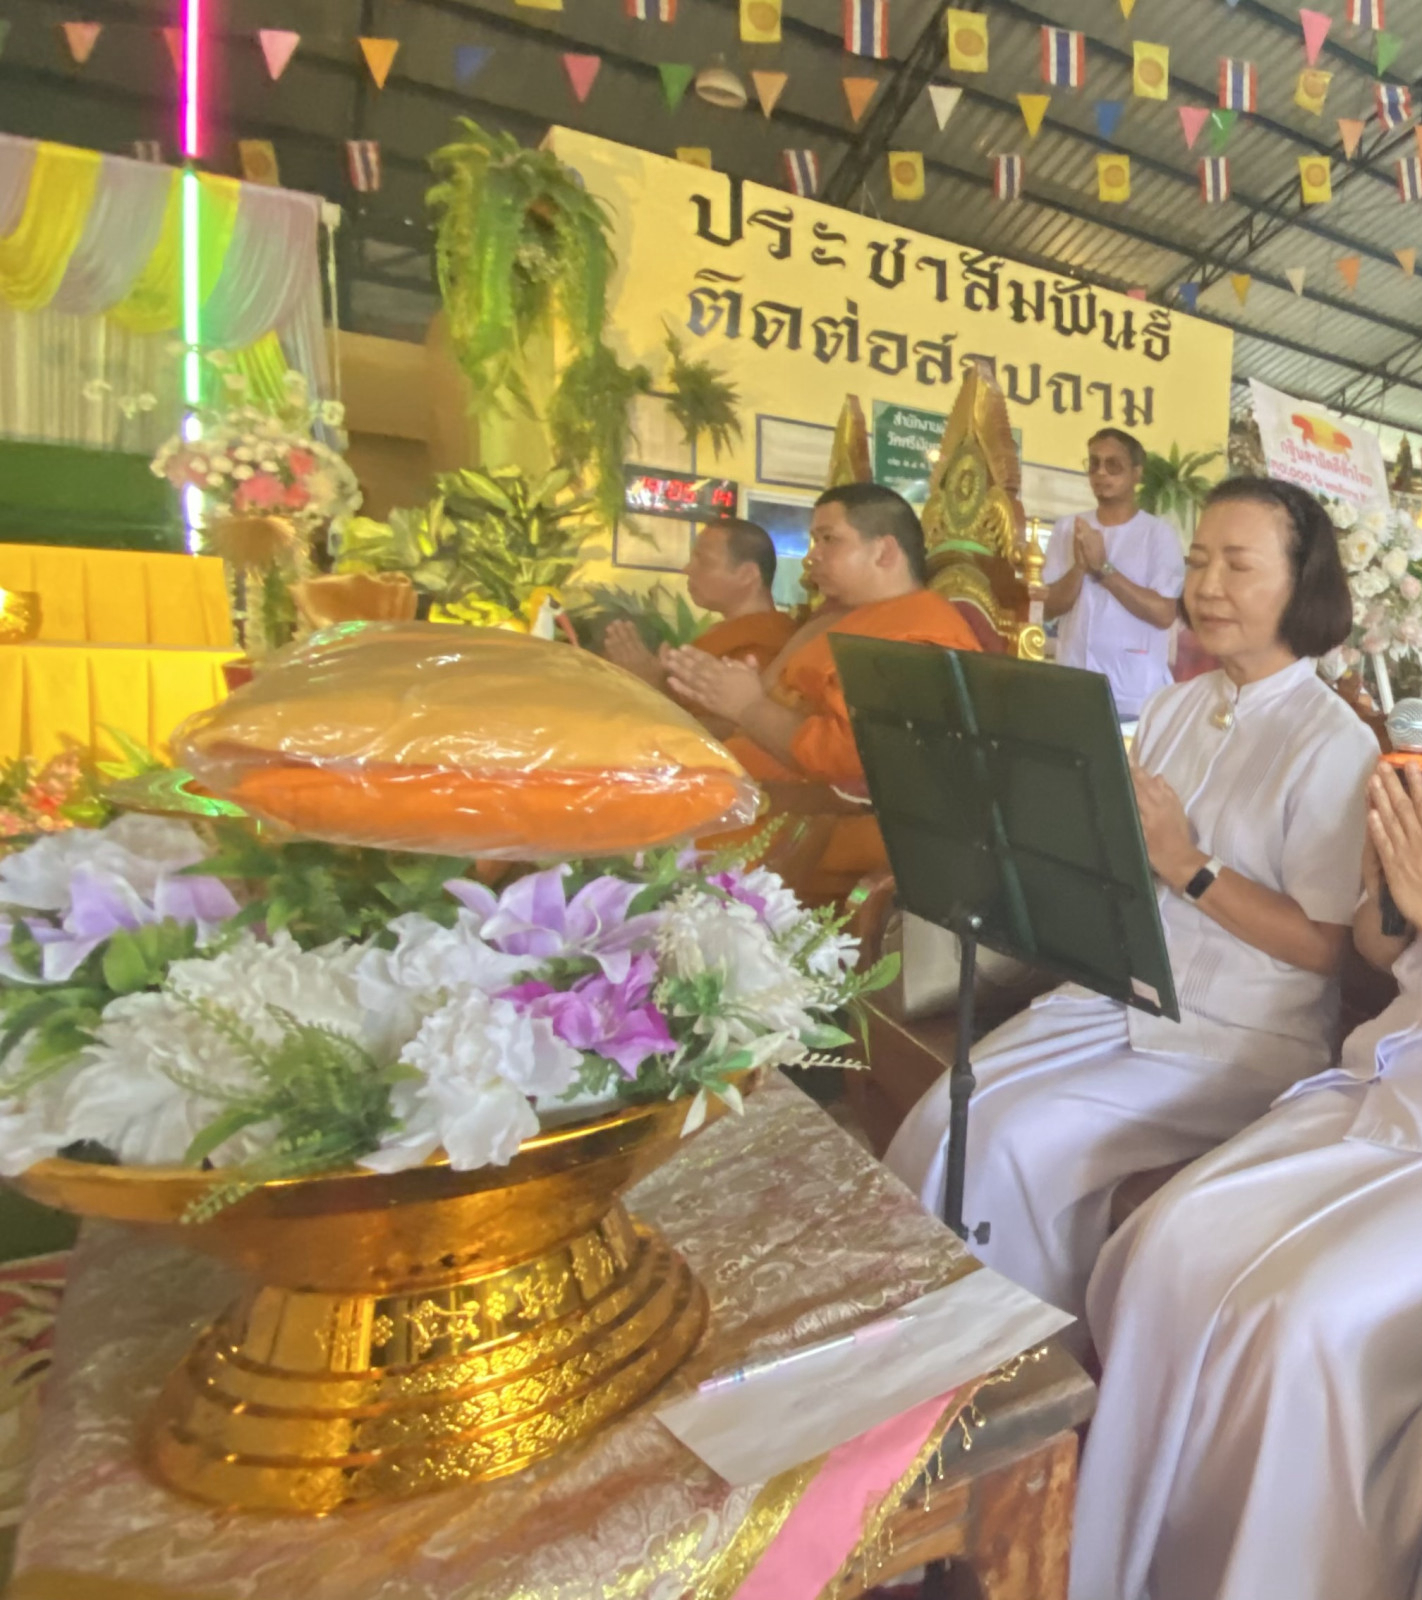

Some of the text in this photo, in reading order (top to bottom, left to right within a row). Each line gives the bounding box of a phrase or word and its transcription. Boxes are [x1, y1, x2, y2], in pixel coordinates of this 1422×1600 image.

[689, 173, 1174, 362] ประชาสัมพันธ์
